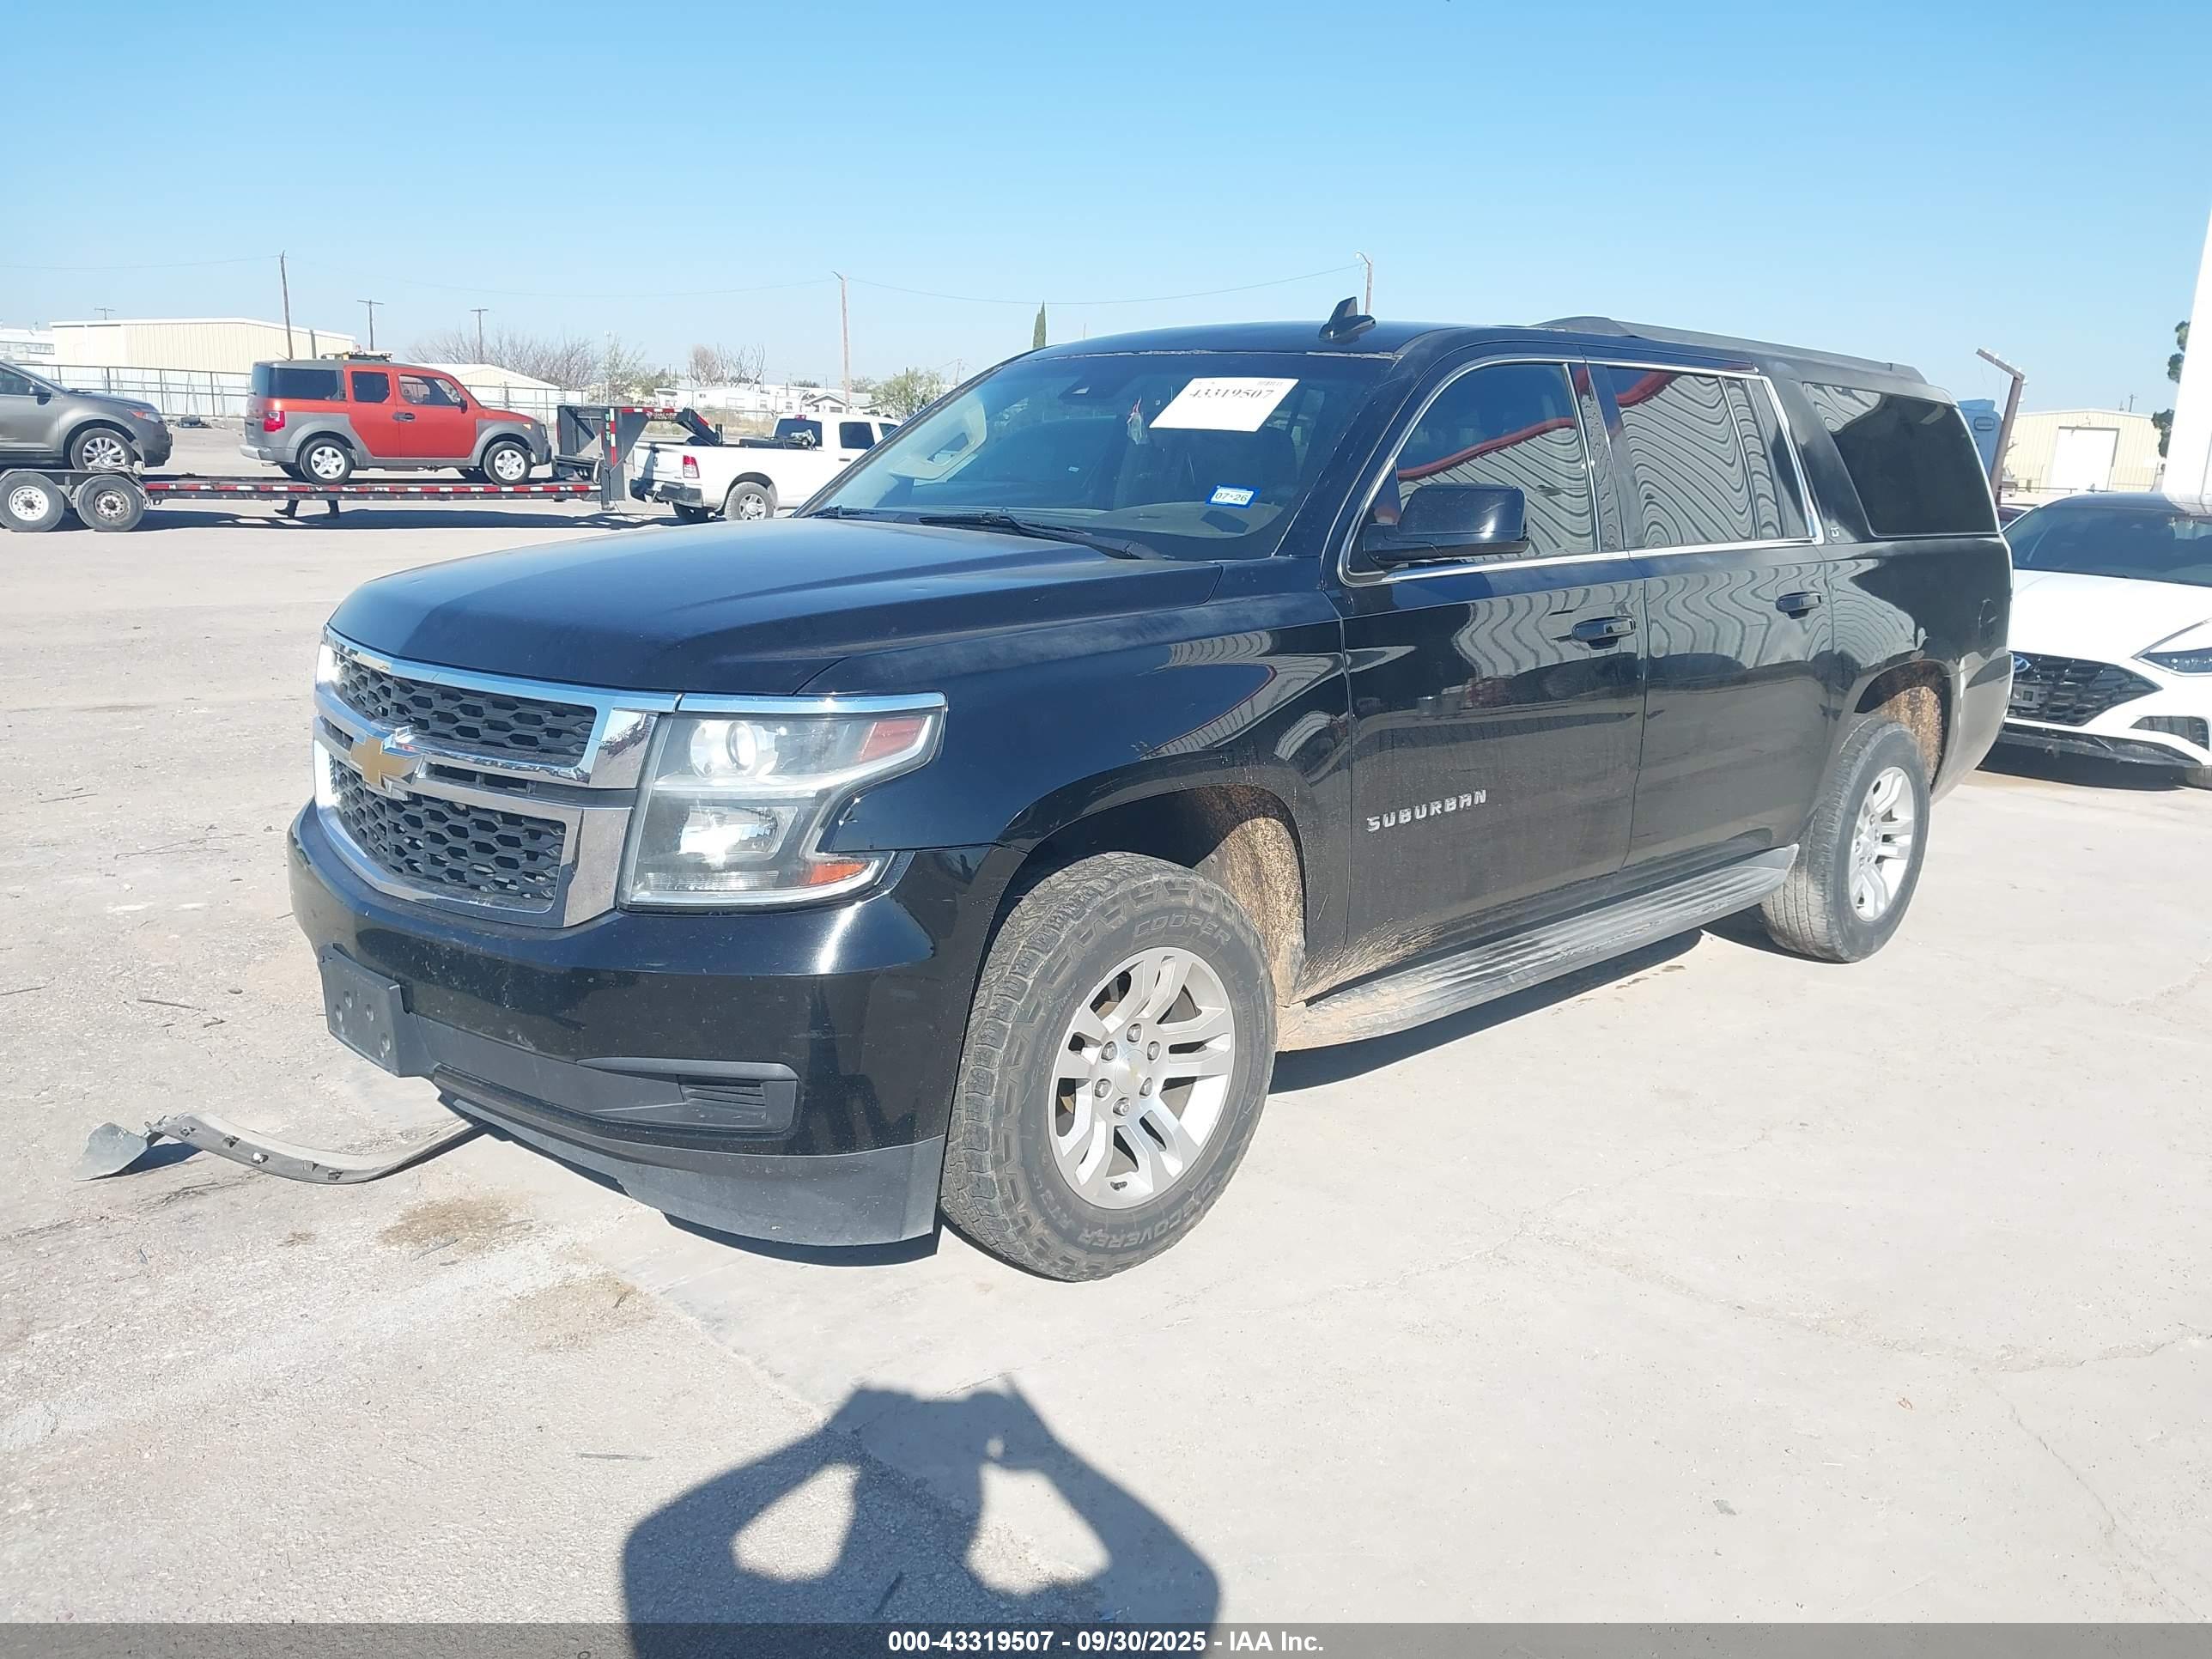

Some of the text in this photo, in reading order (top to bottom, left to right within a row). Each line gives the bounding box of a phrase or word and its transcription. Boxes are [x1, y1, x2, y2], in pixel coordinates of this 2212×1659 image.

[1188, 388, 1275, 399] 43319507
[1365, 789, 1488, 833] SUBURBAN
[1133, 911, 1232, 949] COOPER
